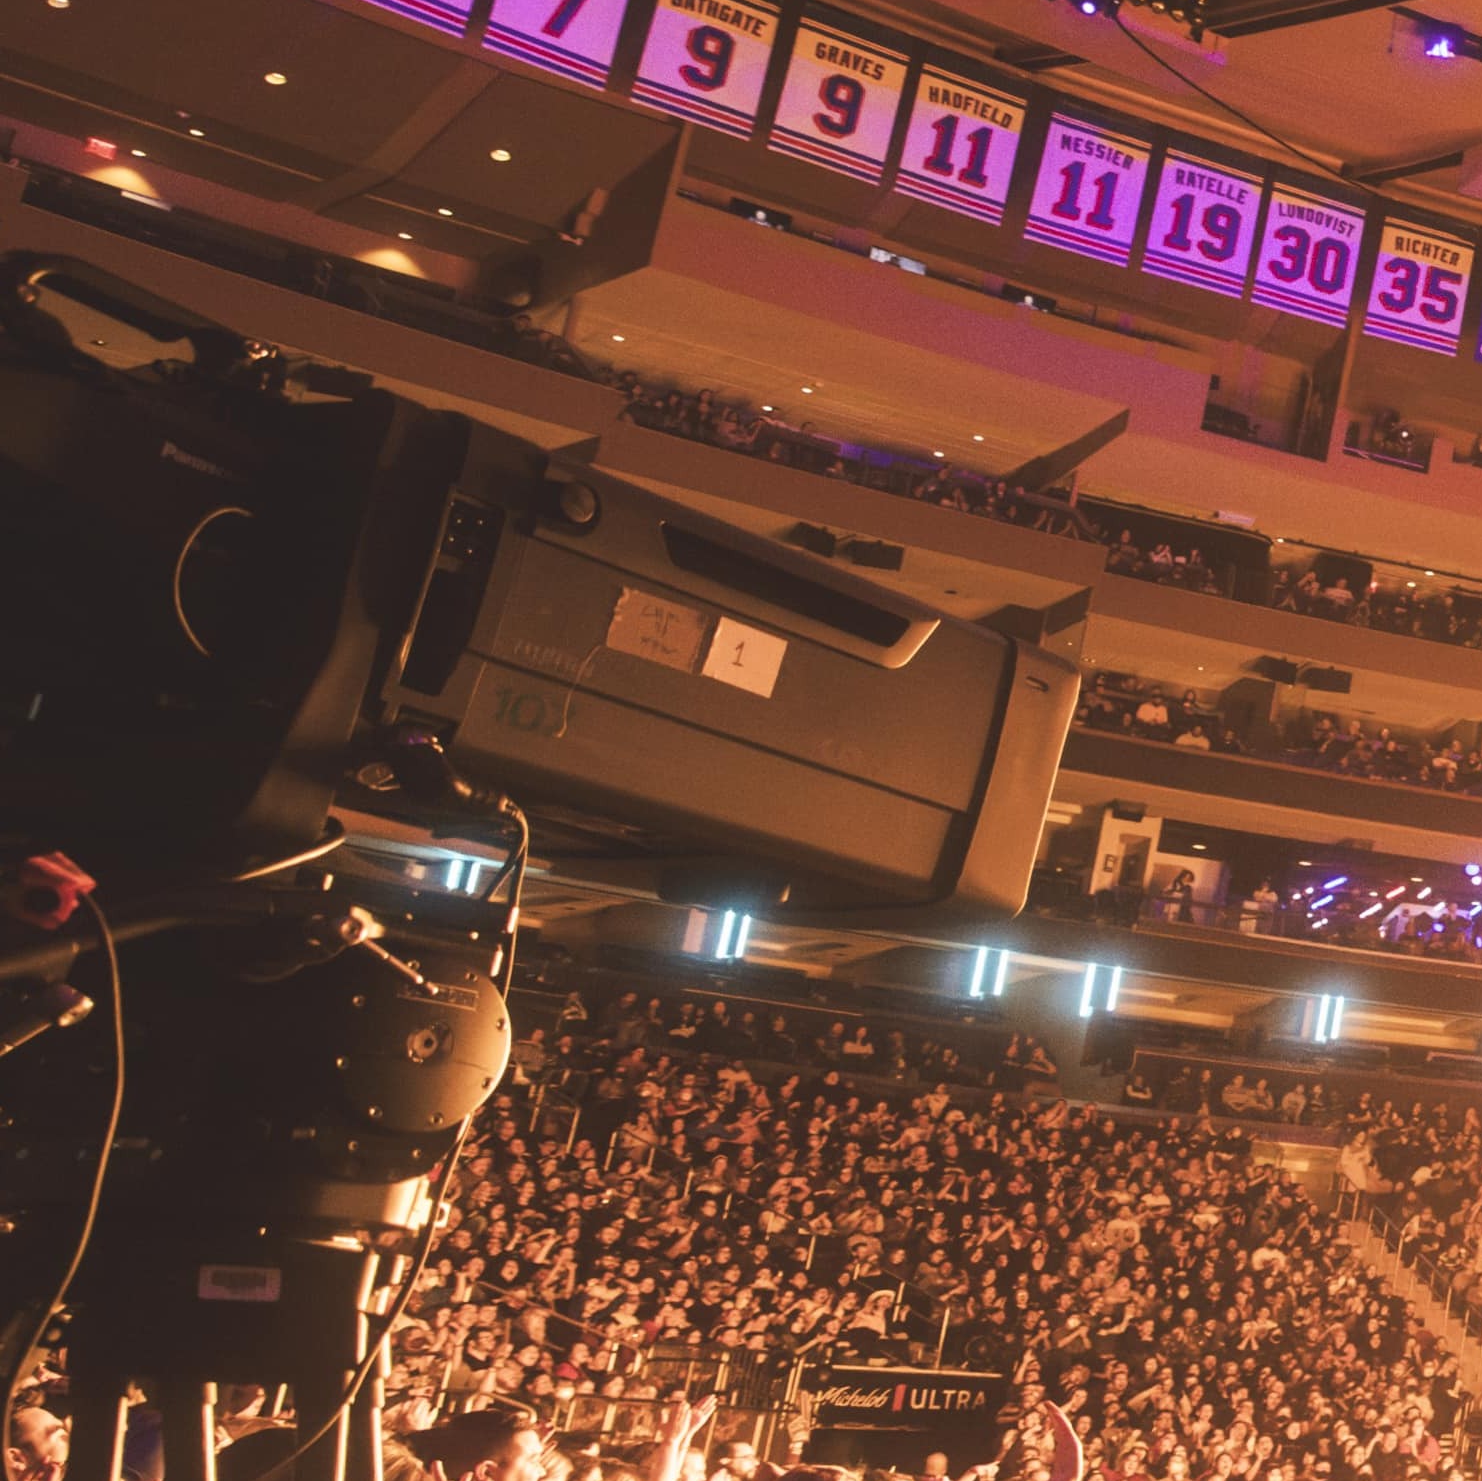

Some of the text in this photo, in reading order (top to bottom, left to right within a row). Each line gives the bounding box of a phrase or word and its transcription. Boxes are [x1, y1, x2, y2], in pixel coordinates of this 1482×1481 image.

[679, 24, 737, 92] 9
[814, 40, 886, 81] GRAVES
[812, 75, 866, 139] 9
[927, 84, 1015, 130] HADFIELD
[924, 114, 992, 189] 11
[1060, 133, 1134, 171] MESSIER
[1052, 161, 1120, 231] 11
[1174, 168, 1251, 206] RATELLE
[1162, 194, 1242, 264] 19
[1277, 202, 1357, 239] LUNDQVIST
[1268, 226, 1351, 295] 30
[1394, 236, 1462, 268] RICHTER
[1379, 258, 1463, 324] 35
[731, 641, 747, 669] 1
[816, 1384, 987, 1412] Michelob ULTRA
